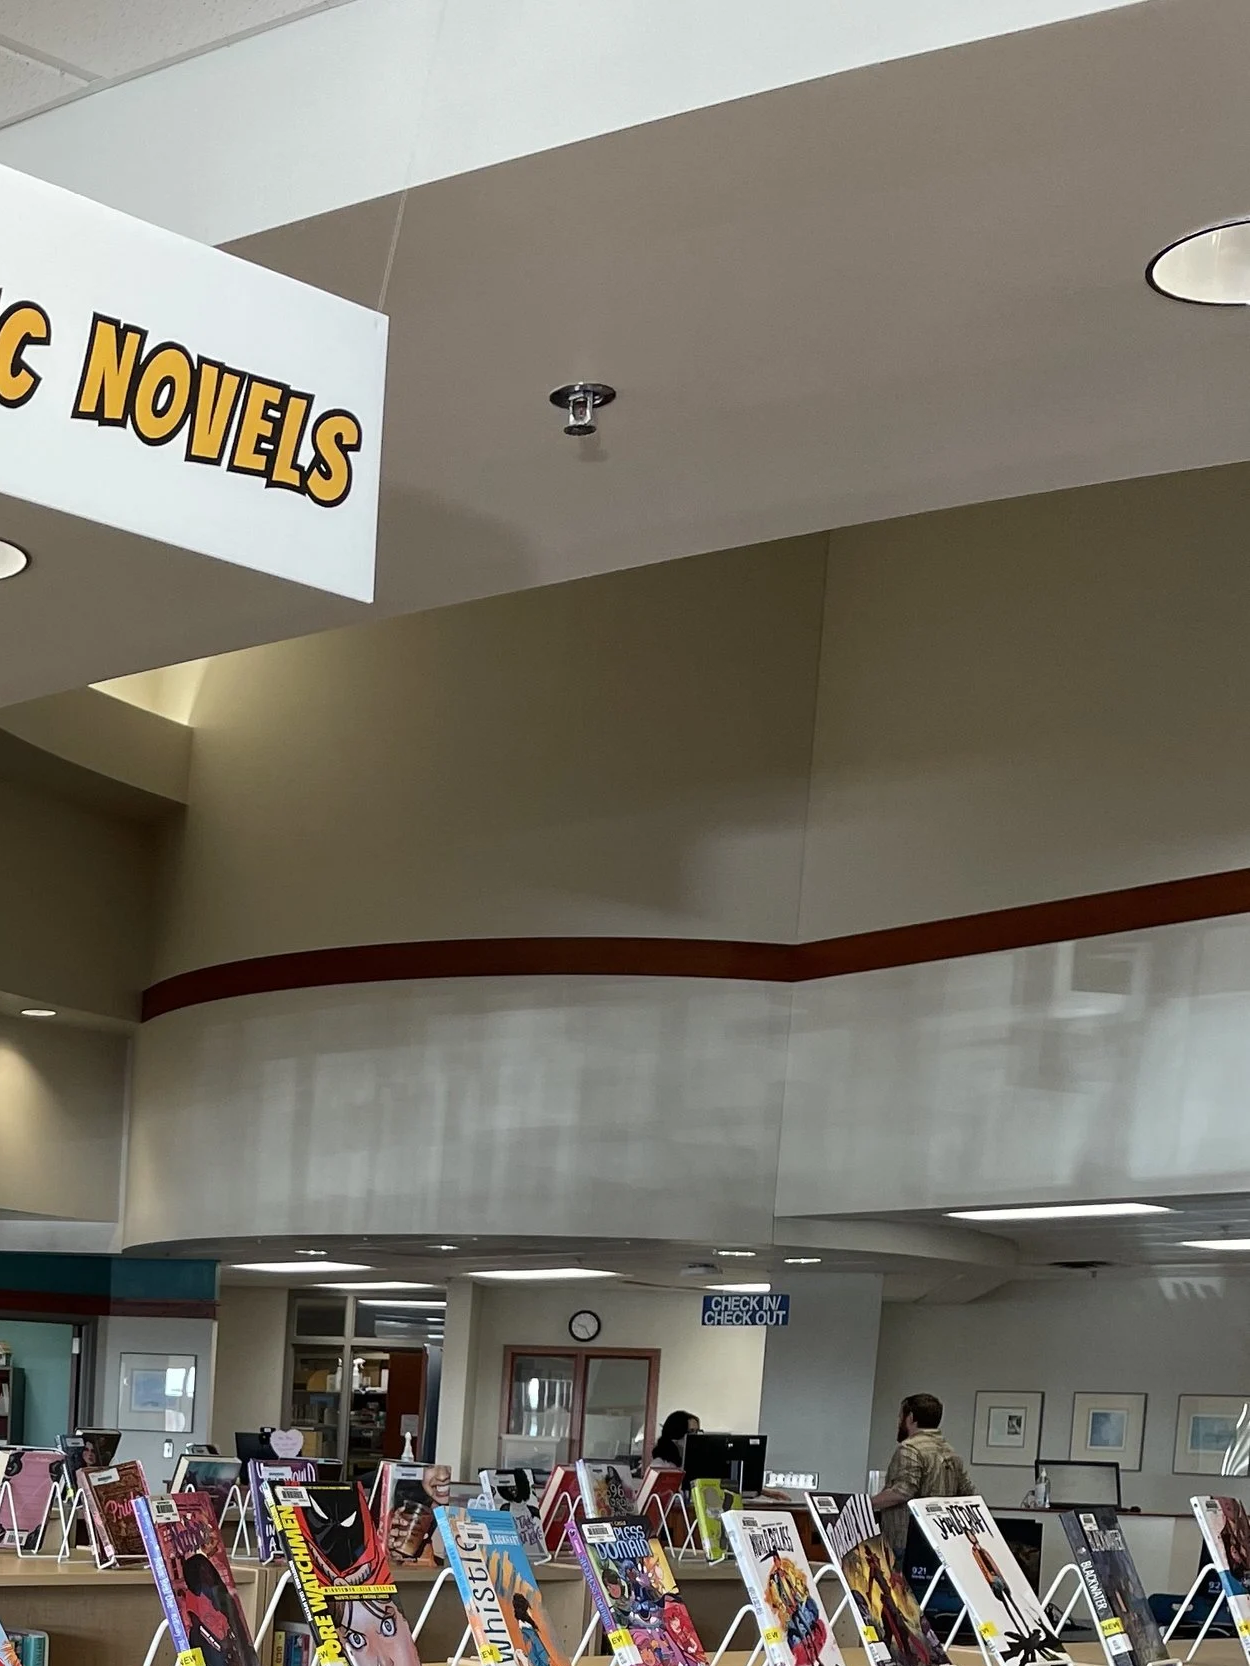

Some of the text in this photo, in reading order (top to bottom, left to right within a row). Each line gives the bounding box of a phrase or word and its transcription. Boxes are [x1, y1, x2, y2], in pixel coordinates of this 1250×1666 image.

[72, 311, 362, 508] NOVELS
[711, 1295, 780, 1311] CHECK IN/
[704, 1310, 786, 1324] CHECK OUT
[616, 1526, 645, 1540] PLESS
[596, 1539, 651, 1560] DOMAIN
[276, 1506, 329, 1614] WATCHMEN
[912, 1567, 927, 1575] 9:21
[1080, 1561, 1108, 1611] BLACKWATER
[1102, 1621, 1121, 1630] NEW
